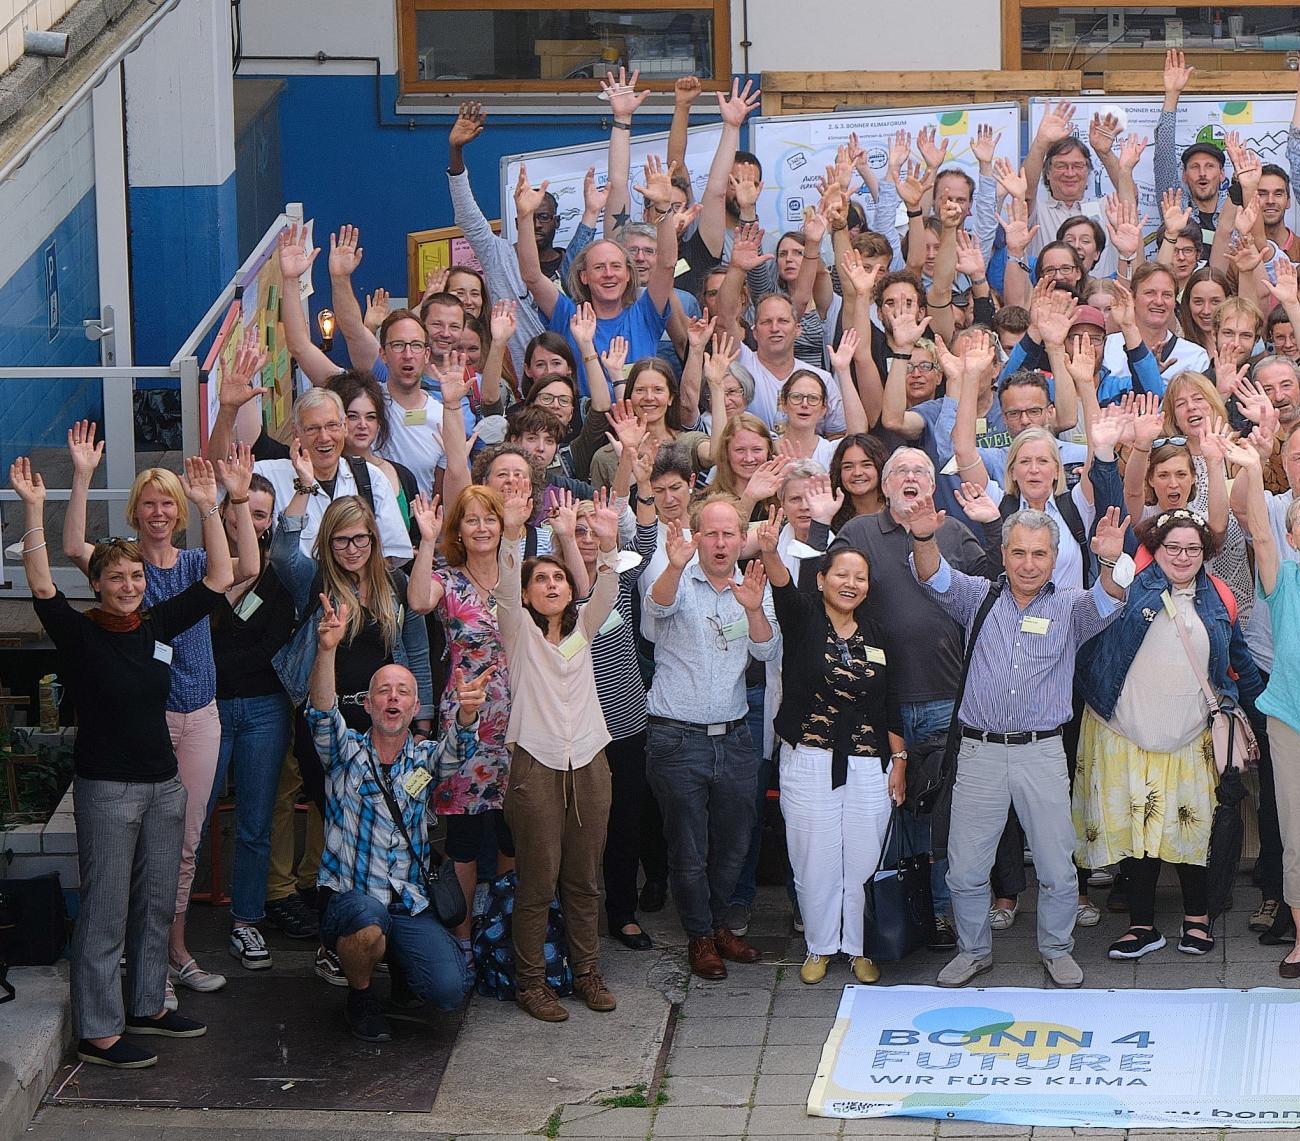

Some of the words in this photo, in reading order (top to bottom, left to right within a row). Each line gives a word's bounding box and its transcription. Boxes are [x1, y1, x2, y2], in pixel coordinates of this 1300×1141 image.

[870, 120, 907, 128] KLIMAFORUM
[878, 1028, 1093, 1048] BONN
[1111, 1030, 1155, 1049] 4
[871, 1050, 1155, 1073] FUTURE
[870, 1075, 932, 1085] WIR
[947, 1074, 1032, 1087] FÜRS
[1045, 1076, 1149, 1087] KLIMA
